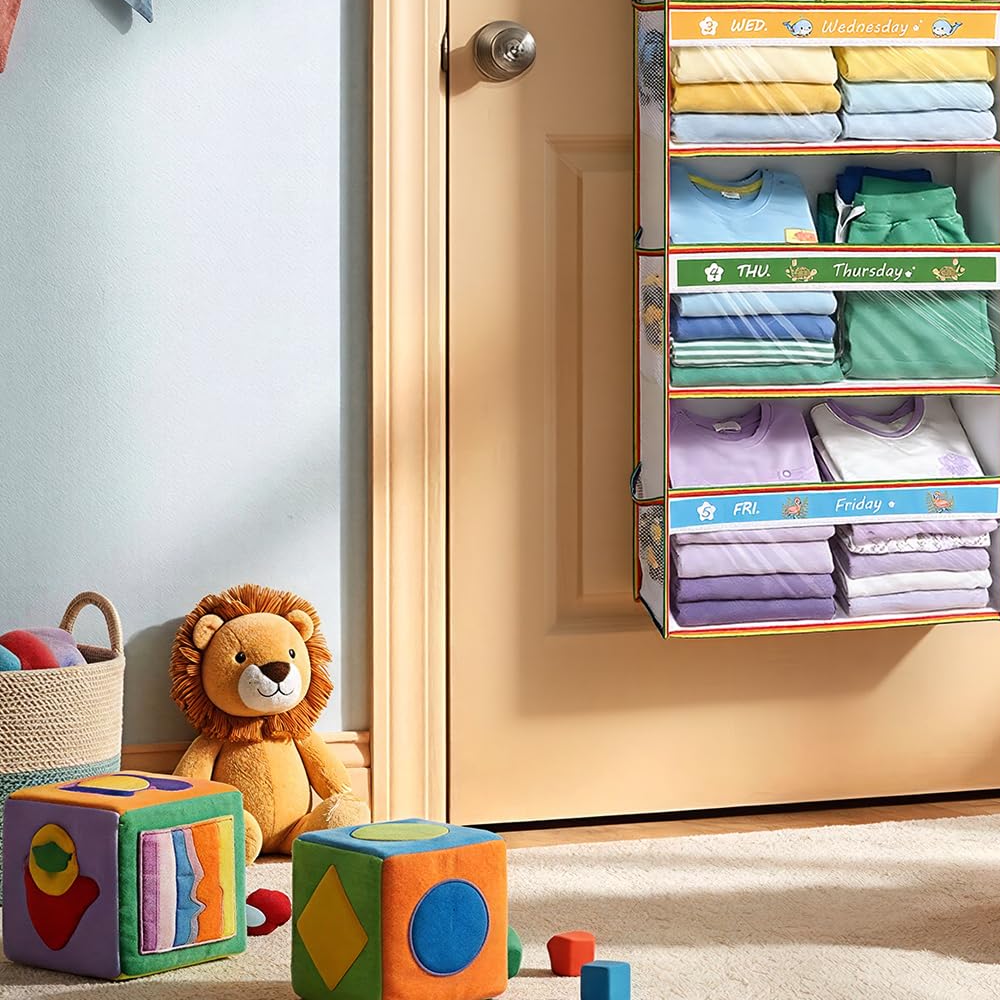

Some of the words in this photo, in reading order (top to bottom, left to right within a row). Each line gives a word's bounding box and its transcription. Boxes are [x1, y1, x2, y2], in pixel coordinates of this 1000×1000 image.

[730, 18, 768, 32] WED.
[821, 19, 909, 37] Wednesday
[736, 264, 771, 278] THU.
[832, 263, 904, 281] Thursday
[733, 501, 760, 516] FRI.
[835, 495, 882, 514] Friday
